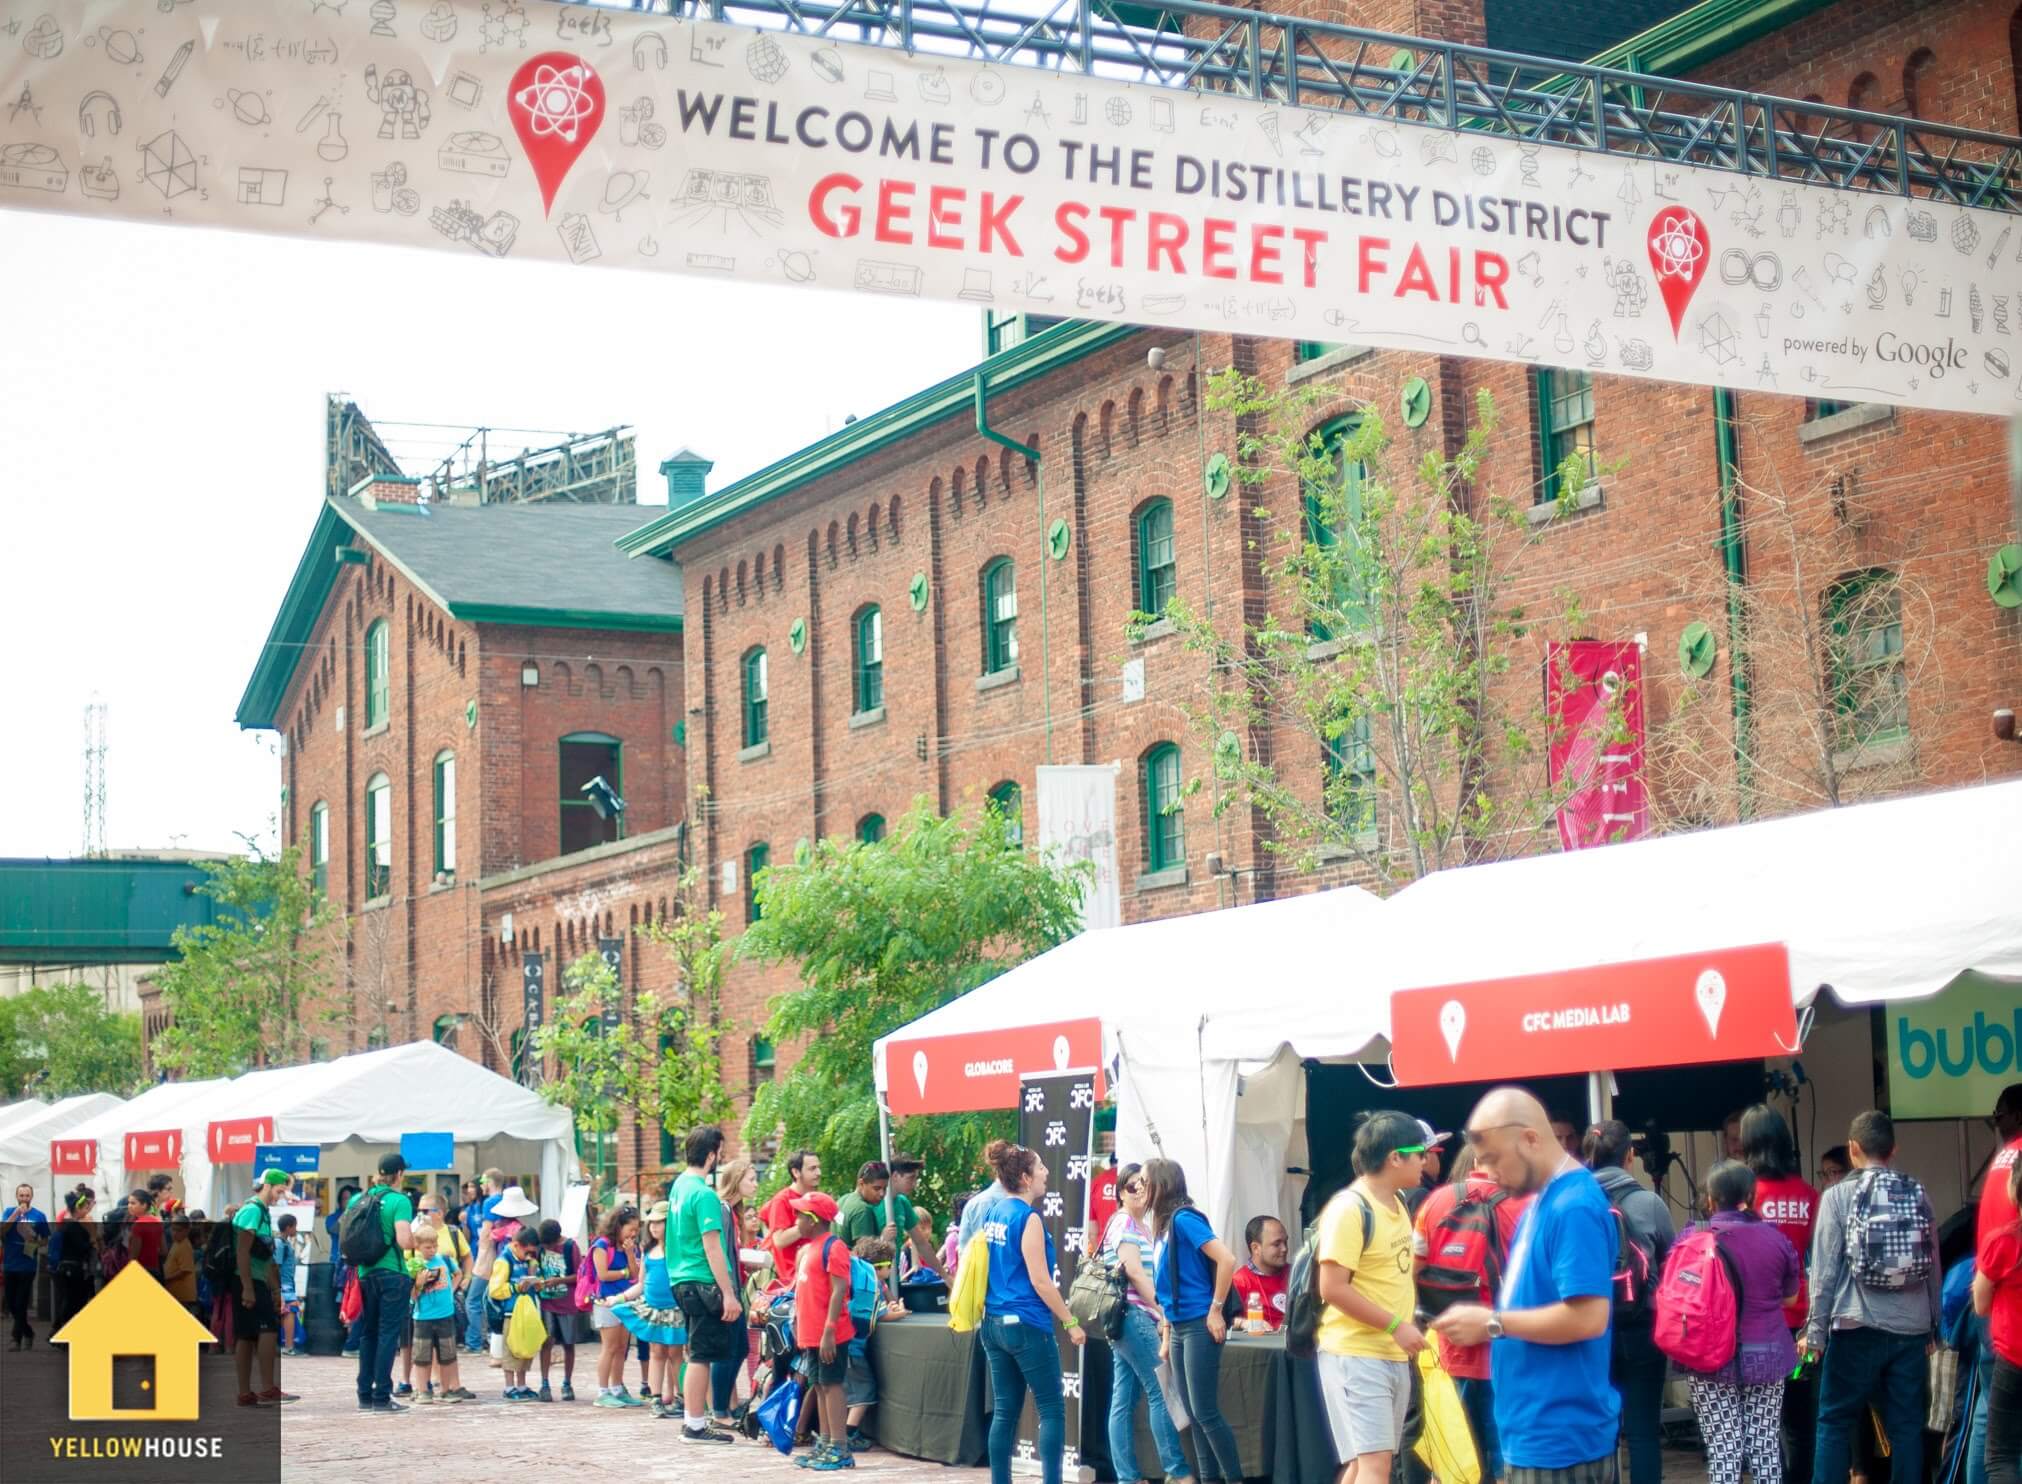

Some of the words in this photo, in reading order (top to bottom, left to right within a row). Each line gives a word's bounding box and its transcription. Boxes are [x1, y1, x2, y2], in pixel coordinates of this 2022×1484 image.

[677, 90, 954, 165] WELCOME
[974, 129, 1040, 174] TO
[1059, 140, 1154, 191] THE
[1175, 155, 1421, 222] DISTILLERY
[1433, 190, 1612, 249] DISTRICT
[807, 172, 1024, 258] GEEK
[1054, 201, 1328, 289] STREET
[1357, 236, 1510, 311] FAIR
[1783, 336, 1849, 357] powered
[1852, 337, 1869, 364] by
[1876, 331, 1968, 379] Google
[1522, 1012, 1551, 1032] CFC
[1552, 1007, 1600, 1029] MEDIA
[1601, 1002, 1631, 1025] LAB
[1762, 1200, 1810, 1219] GEEK
